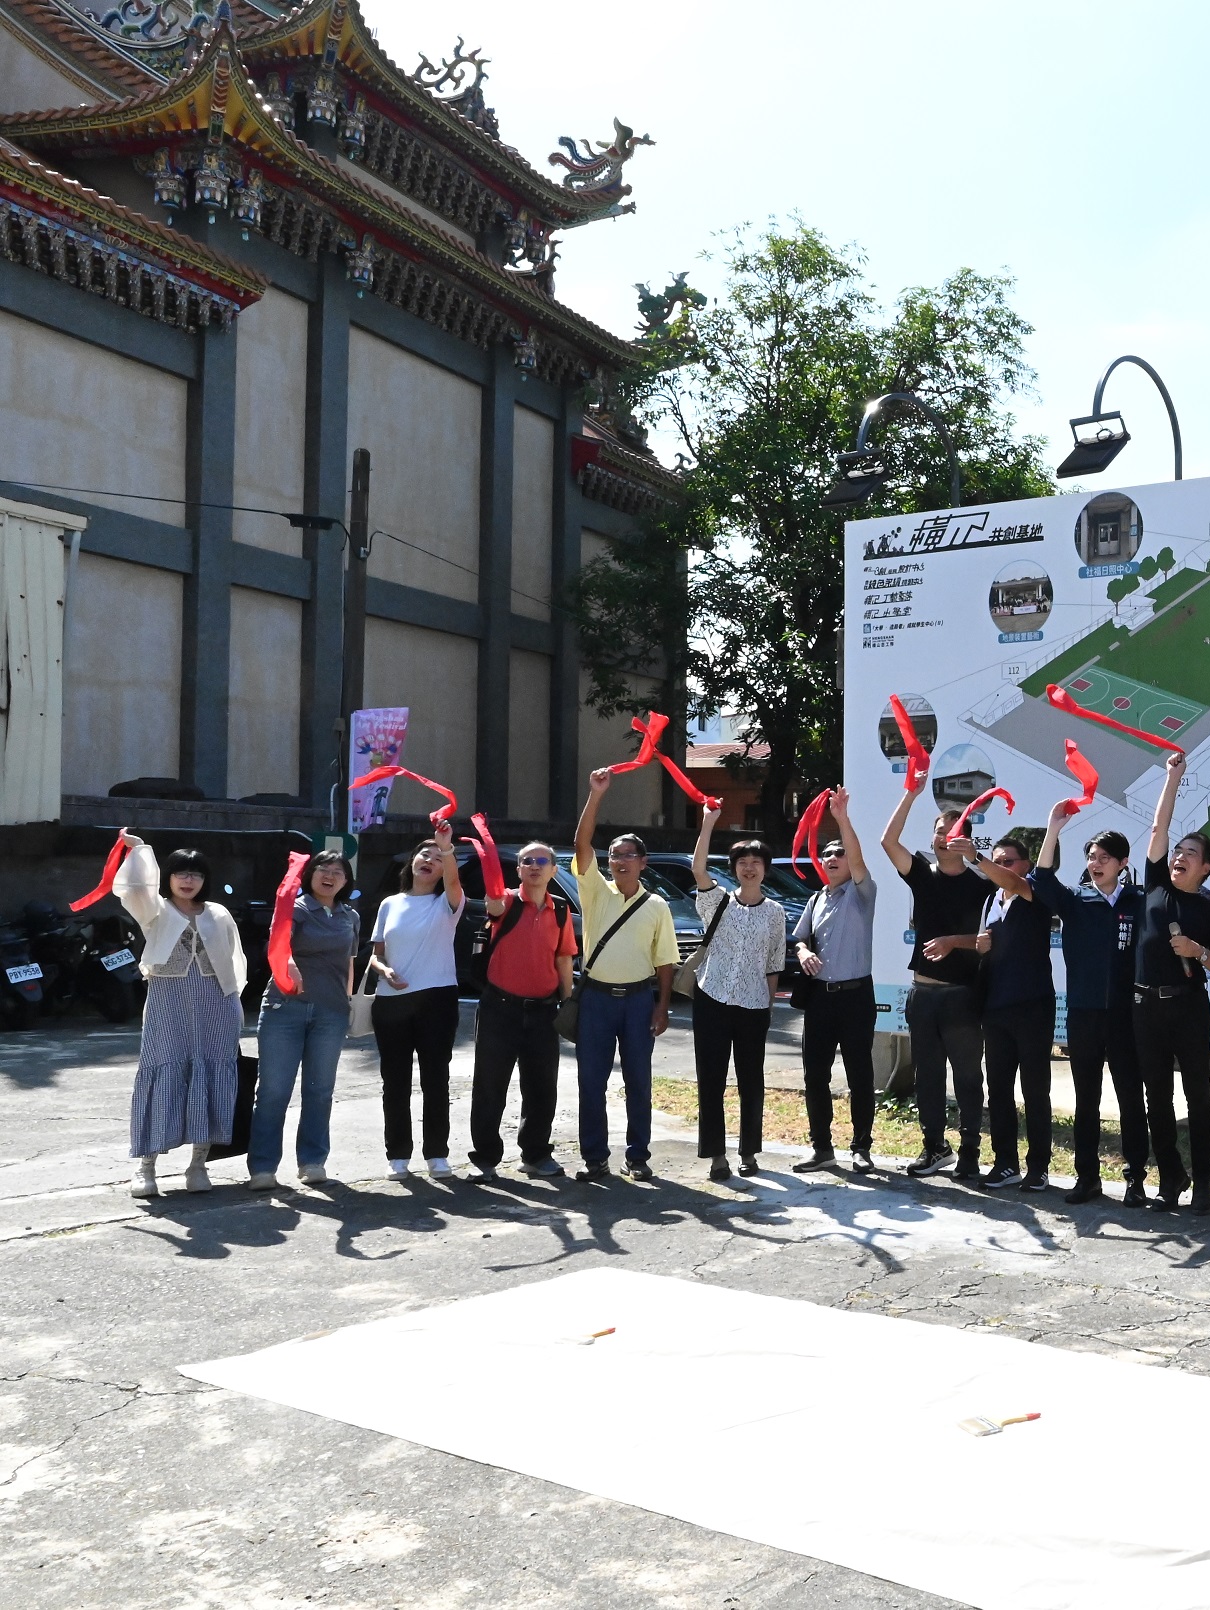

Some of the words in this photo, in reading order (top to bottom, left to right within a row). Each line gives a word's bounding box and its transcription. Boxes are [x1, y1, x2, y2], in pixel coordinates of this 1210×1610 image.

[1086, 563, 1132, 578] 社福日照中心
[1008, 666, 1020, 675] 112
